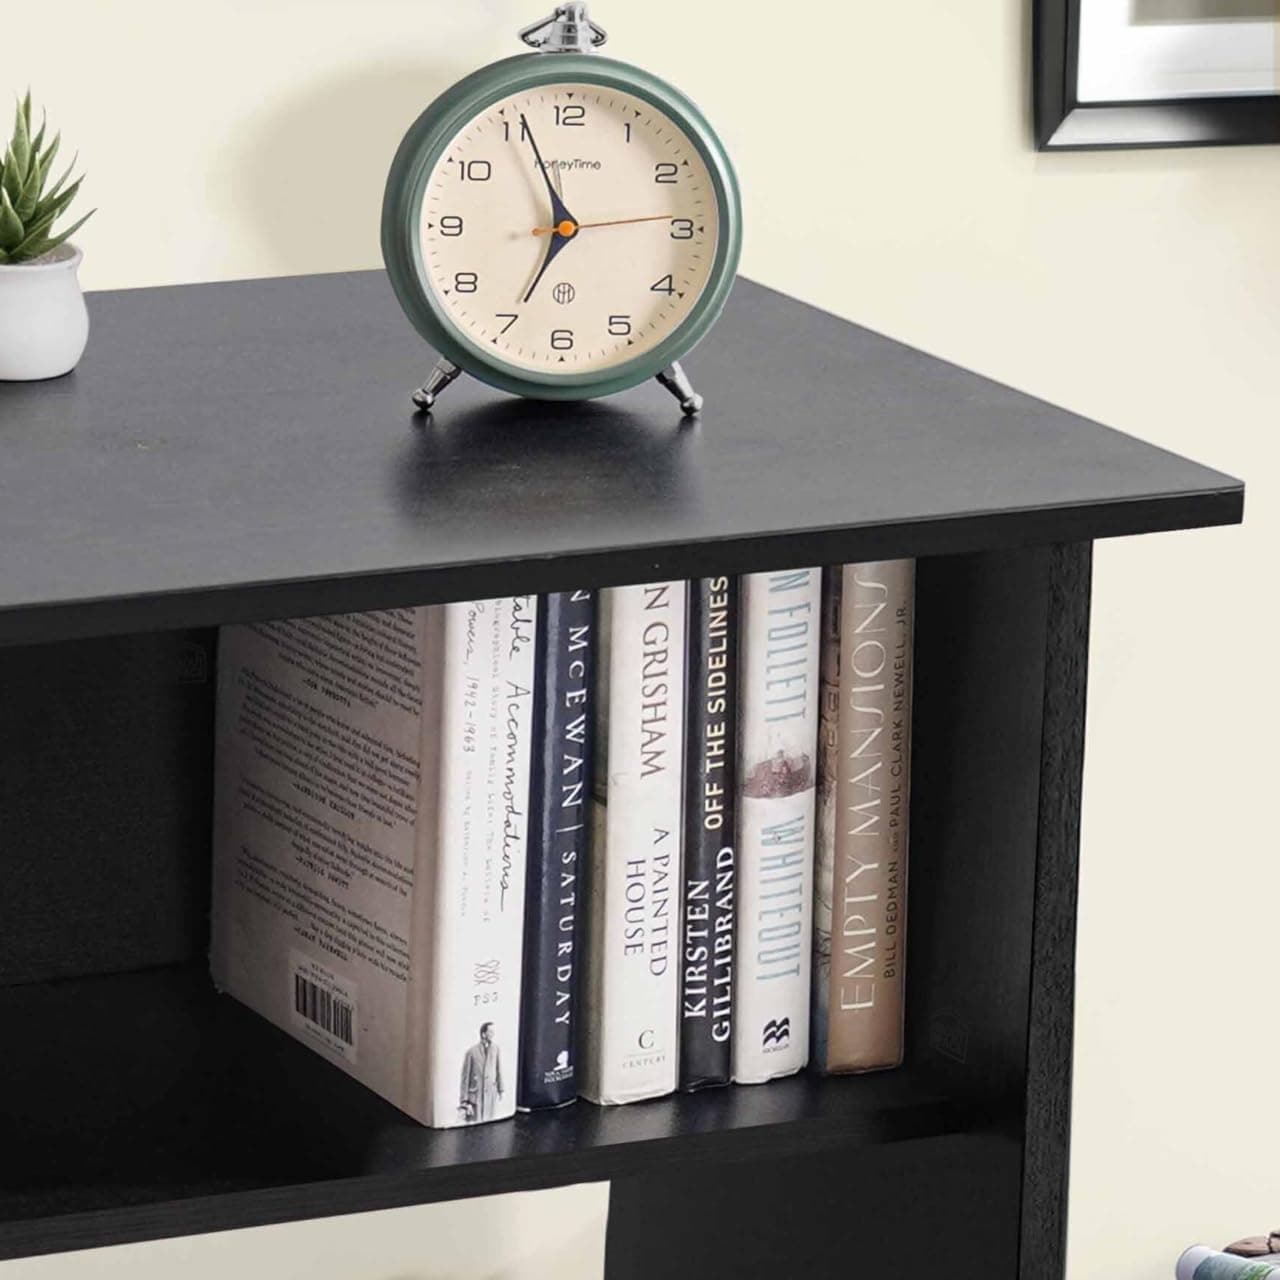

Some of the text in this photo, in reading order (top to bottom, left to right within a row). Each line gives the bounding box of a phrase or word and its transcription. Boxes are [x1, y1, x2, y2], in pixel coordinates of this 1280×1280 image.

[553, 105, 586, 127] 12
[623, 122, 631, 143] 1
[458, 160, 492, 182] 10
[655, 163, 678, 184] 2
[440, 216, 463, 237] 9
[670, 219, 694, 240] 3
[454, 272, 478, 293] 8
[650, 274, 677, 296] 4
[495, 314, 519, 335] 7
[550, 329, 574, 350] 6
[608, 315, 632, 336] 5
[764, 601, 812, 722] FOLLETT
[463, 675, 480, 753] 1942-1963
[641, 621, 669, 780] GRISHAM
[704, 576, 729, 830] OFF THE SIDELINES
[890, 719, 903, 777] CLARK
[500, 680, 531, 912] Accommodations
[841, 572, 888, 1010] EMPTY MANSIONS
[888, 787, 902, 828] PAUL
[624, 859, 646, 956] HOUSE
[649, 828, 670, 976] A PAINTED
[756, 815, 805, 981] WHITEOUT
[885, 860, 899, 935] DEDMAN
[555, 851, 577, 1024] SATURDAY
[684, 880, 710, 1018] KIRSTEN
[712, 846, 734, 1042] GILLIBRAND
[883, 941, 897, 979] BILL
[638, 1030, 655, 1050] C
